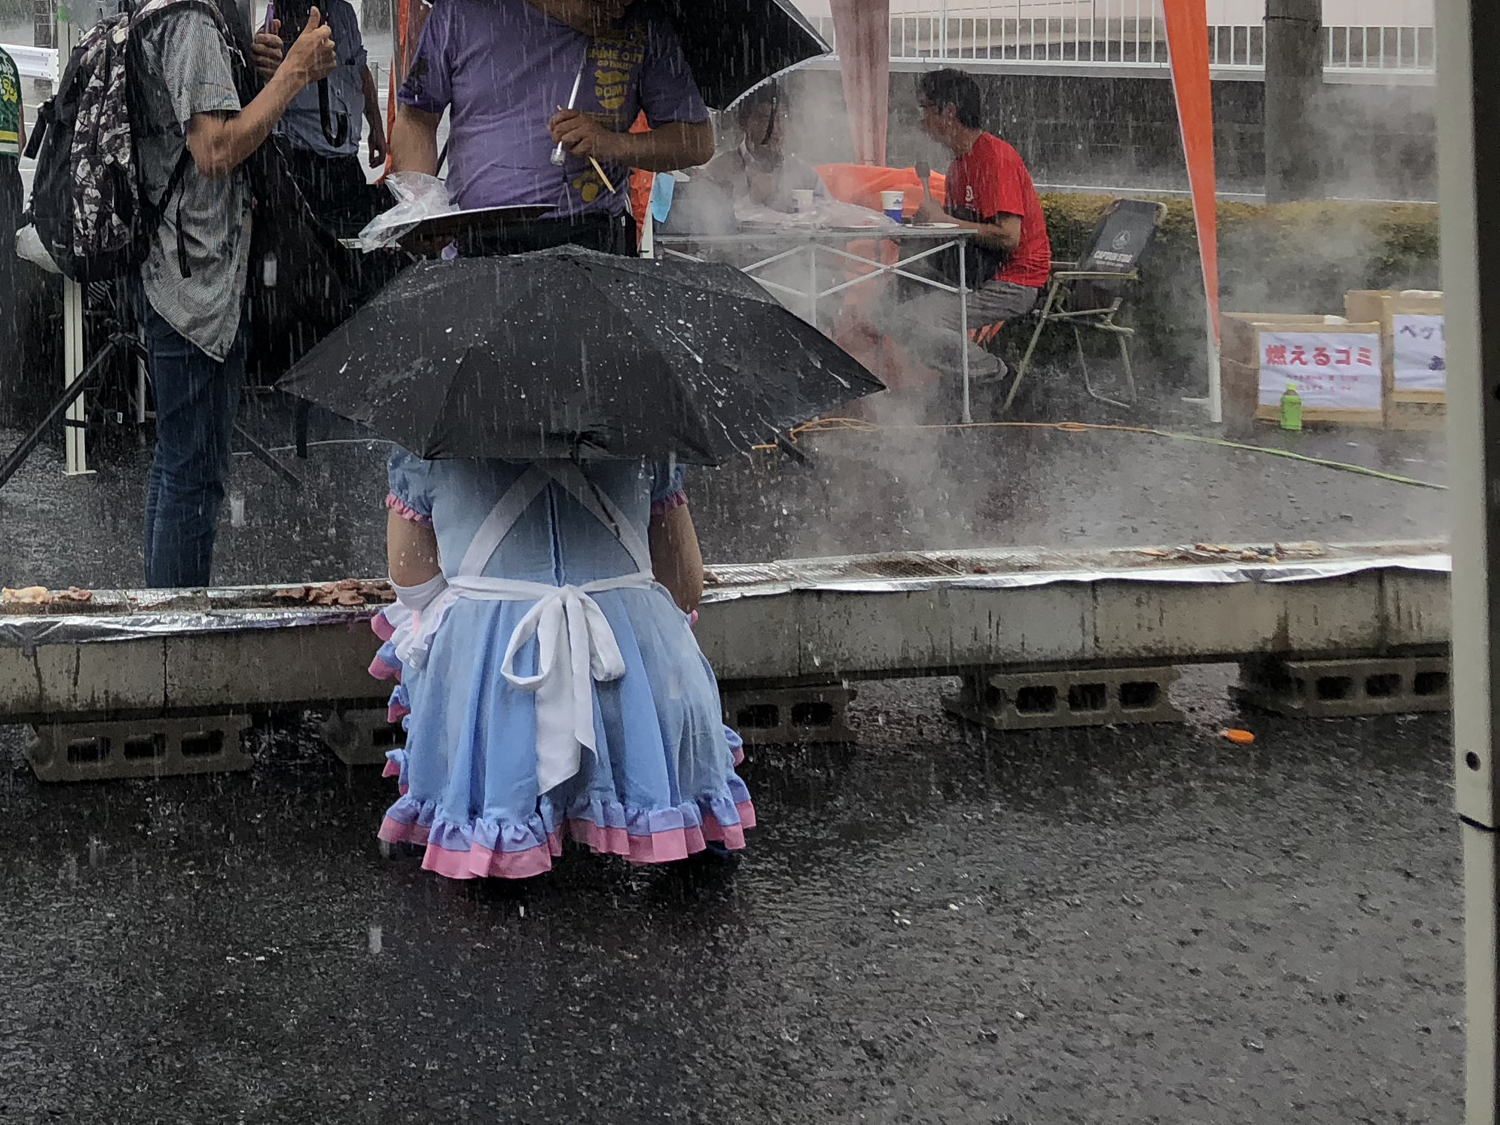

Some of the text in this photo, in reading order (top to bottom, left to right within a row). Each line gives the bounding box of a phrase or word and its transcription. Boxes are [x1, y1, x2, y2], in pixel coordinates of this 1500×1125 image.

[1265, 344, 1373, 367] 燃えるゴミ
